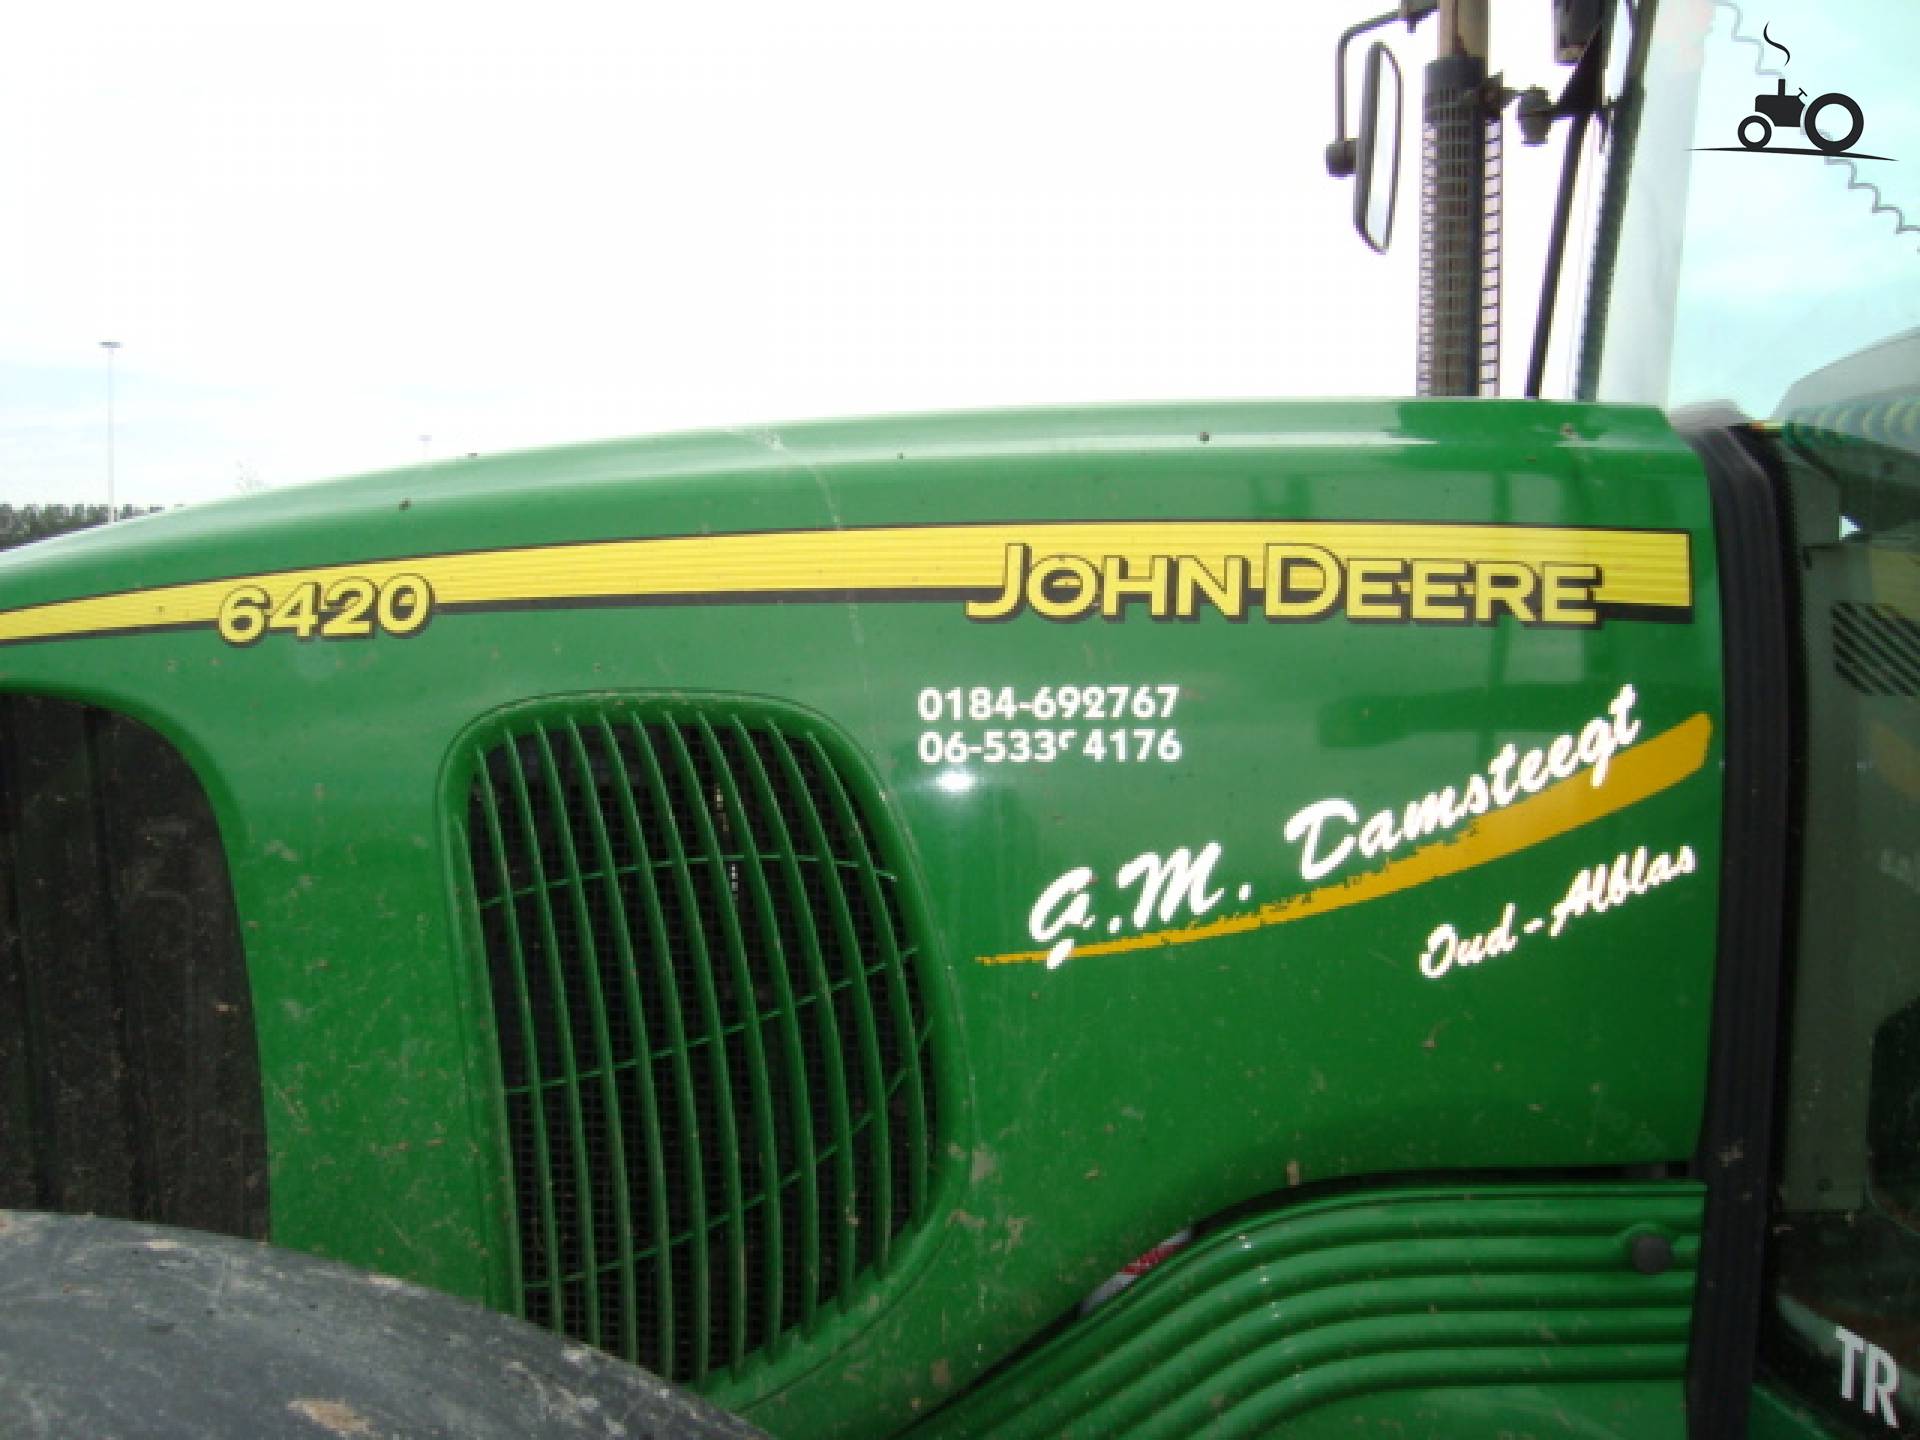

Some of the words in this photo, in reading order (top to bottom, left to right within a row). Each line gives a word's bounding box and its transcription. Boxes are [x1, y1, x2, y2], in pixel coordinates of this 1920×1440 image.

[218, 573, 435, 646] 6420
[966, 542, 1250, 622] JOHN
[1262, 542, 1602, 628] DEERE
[917, 684, 1180, 721] 0184-692767
[1284, 683, 1643, 881] Damsteegt
